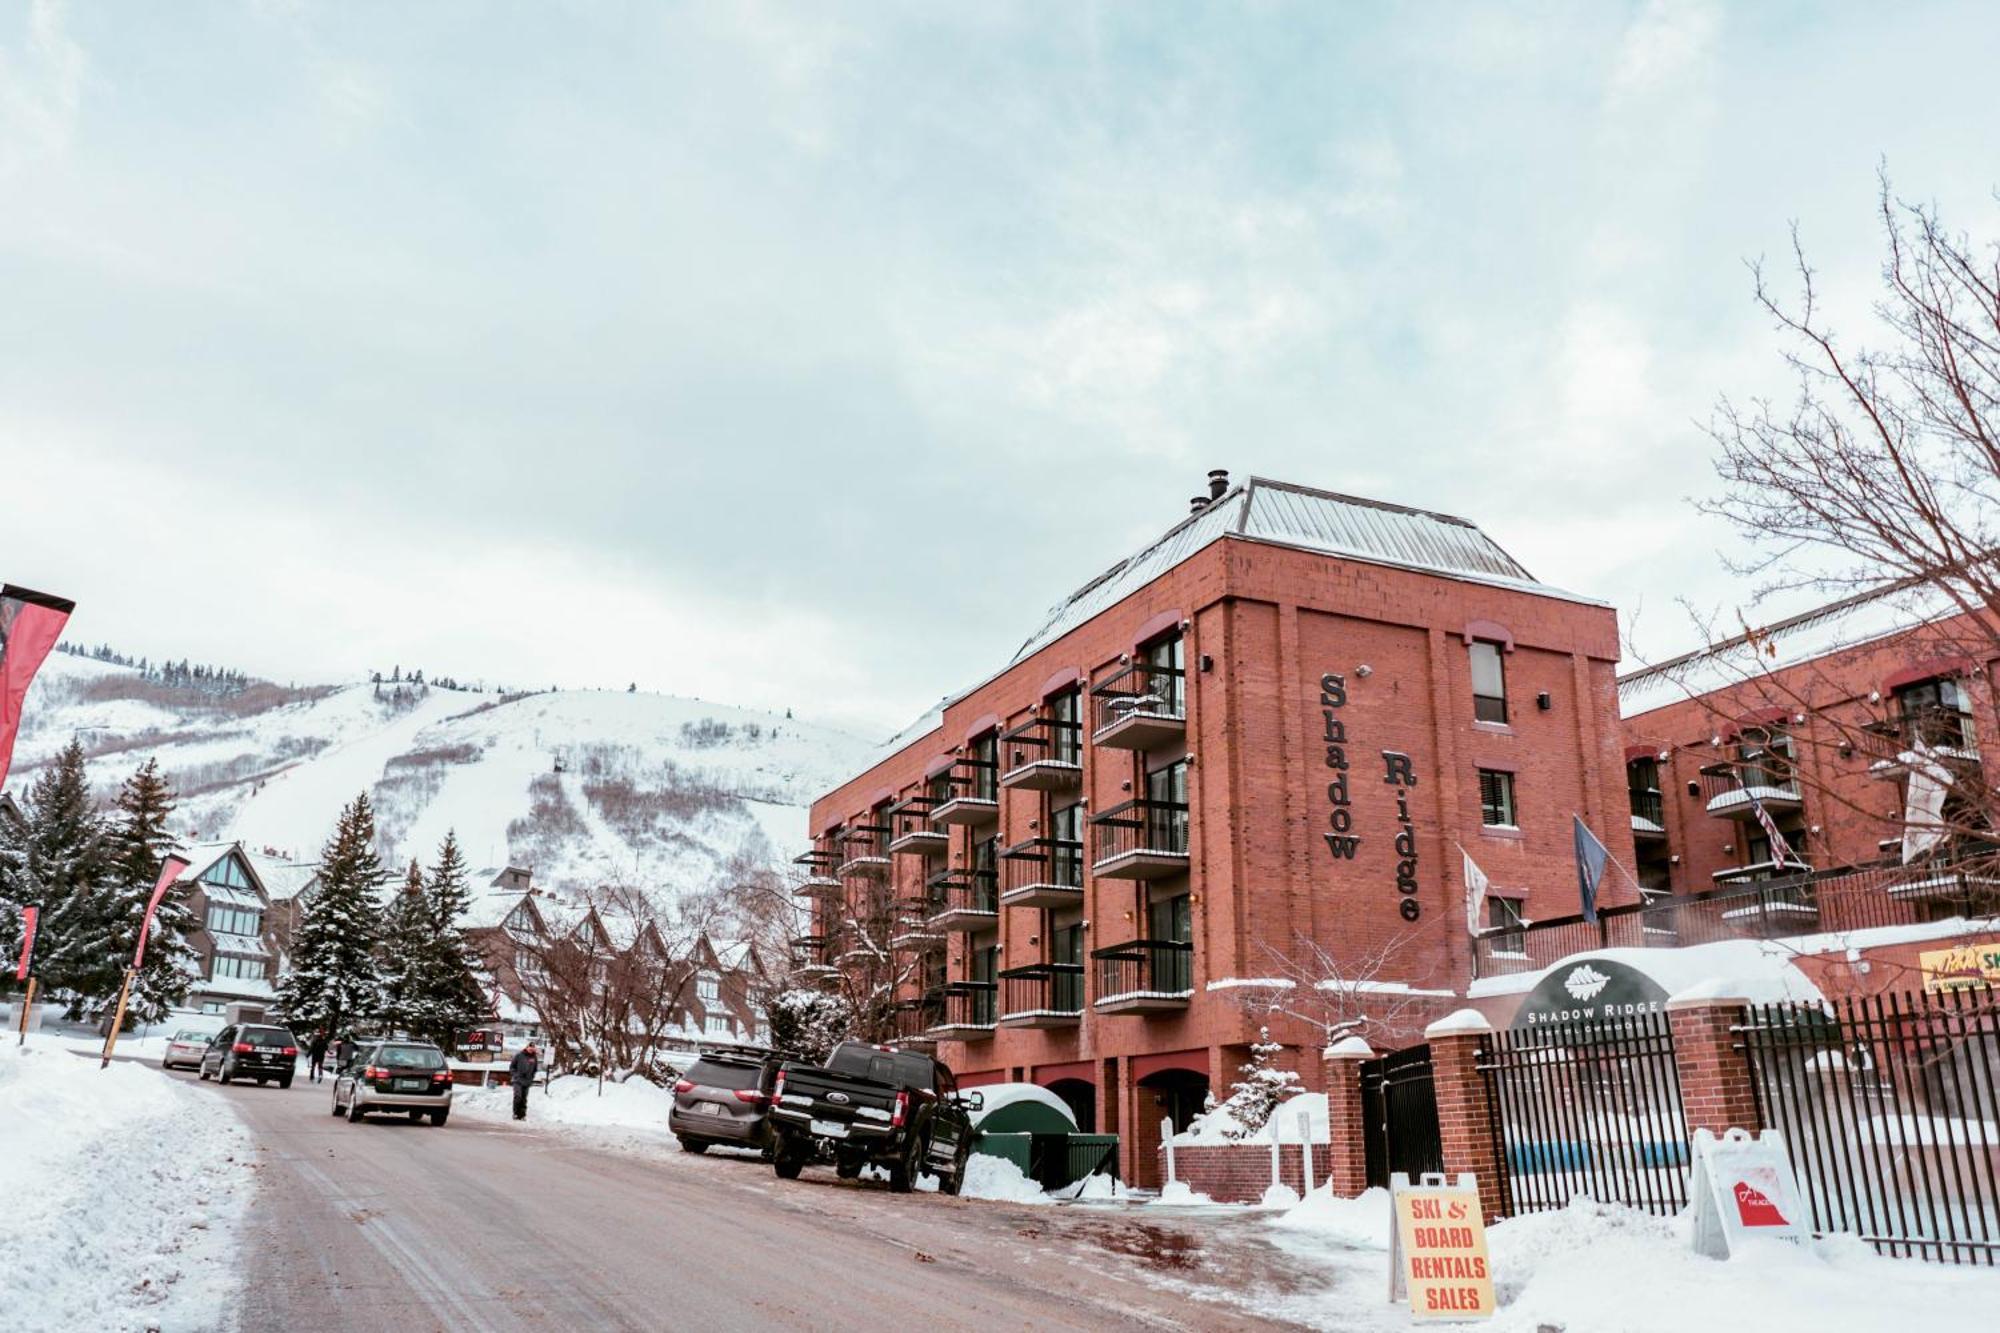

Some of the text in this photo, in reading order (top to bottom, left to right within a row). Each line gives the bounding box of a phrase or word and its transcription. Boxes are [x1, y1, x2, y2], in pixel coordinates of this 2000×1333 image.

[1320, 673, 1361, 860] Shadow
[1382, 750, 1420, 922] Ridge
[1528, 1002, 1658, 1024] SHADOW RIDGE
[1411, 1199, 1468, 1220] SKI &
[1414, 1227, 1474, 1249] BOARD
[1411, 1257, 1486, 1279] RENTALS
[1426, 1287, 1480, 1310] SALES
